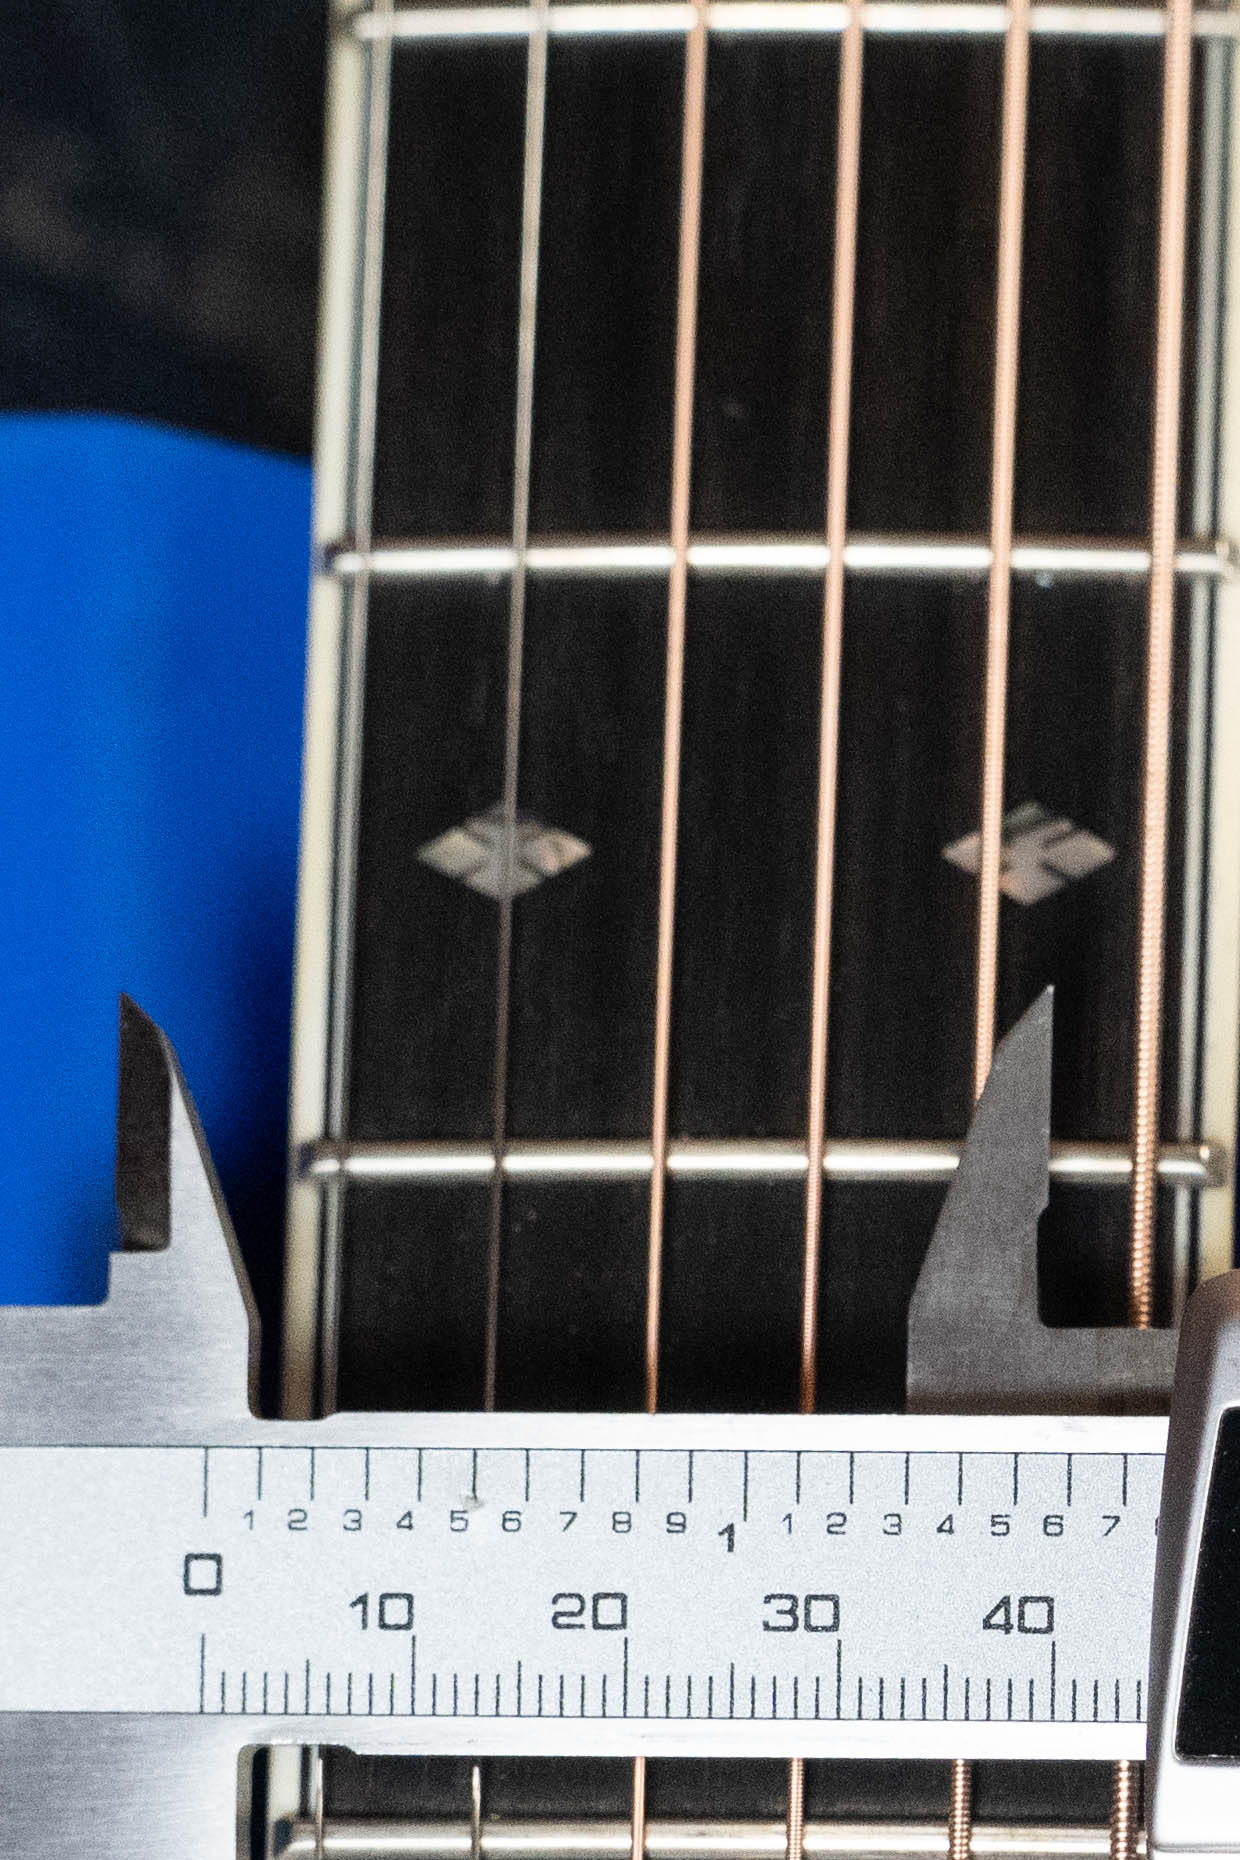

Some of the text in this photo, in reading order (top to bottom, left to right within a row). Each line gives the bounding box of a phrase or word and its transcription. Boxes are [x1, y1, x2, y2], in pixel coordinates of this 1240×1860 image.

[243, 1508, 687, 1534] 1 2 3 4 5 6 7 8 9
[781, 1512, 1121, 1538] 1 2 3 4 5 6 7
[718, 1522, 735, 1553] 1
[349, 1592, 1055, 1635] 10 20 30 40
